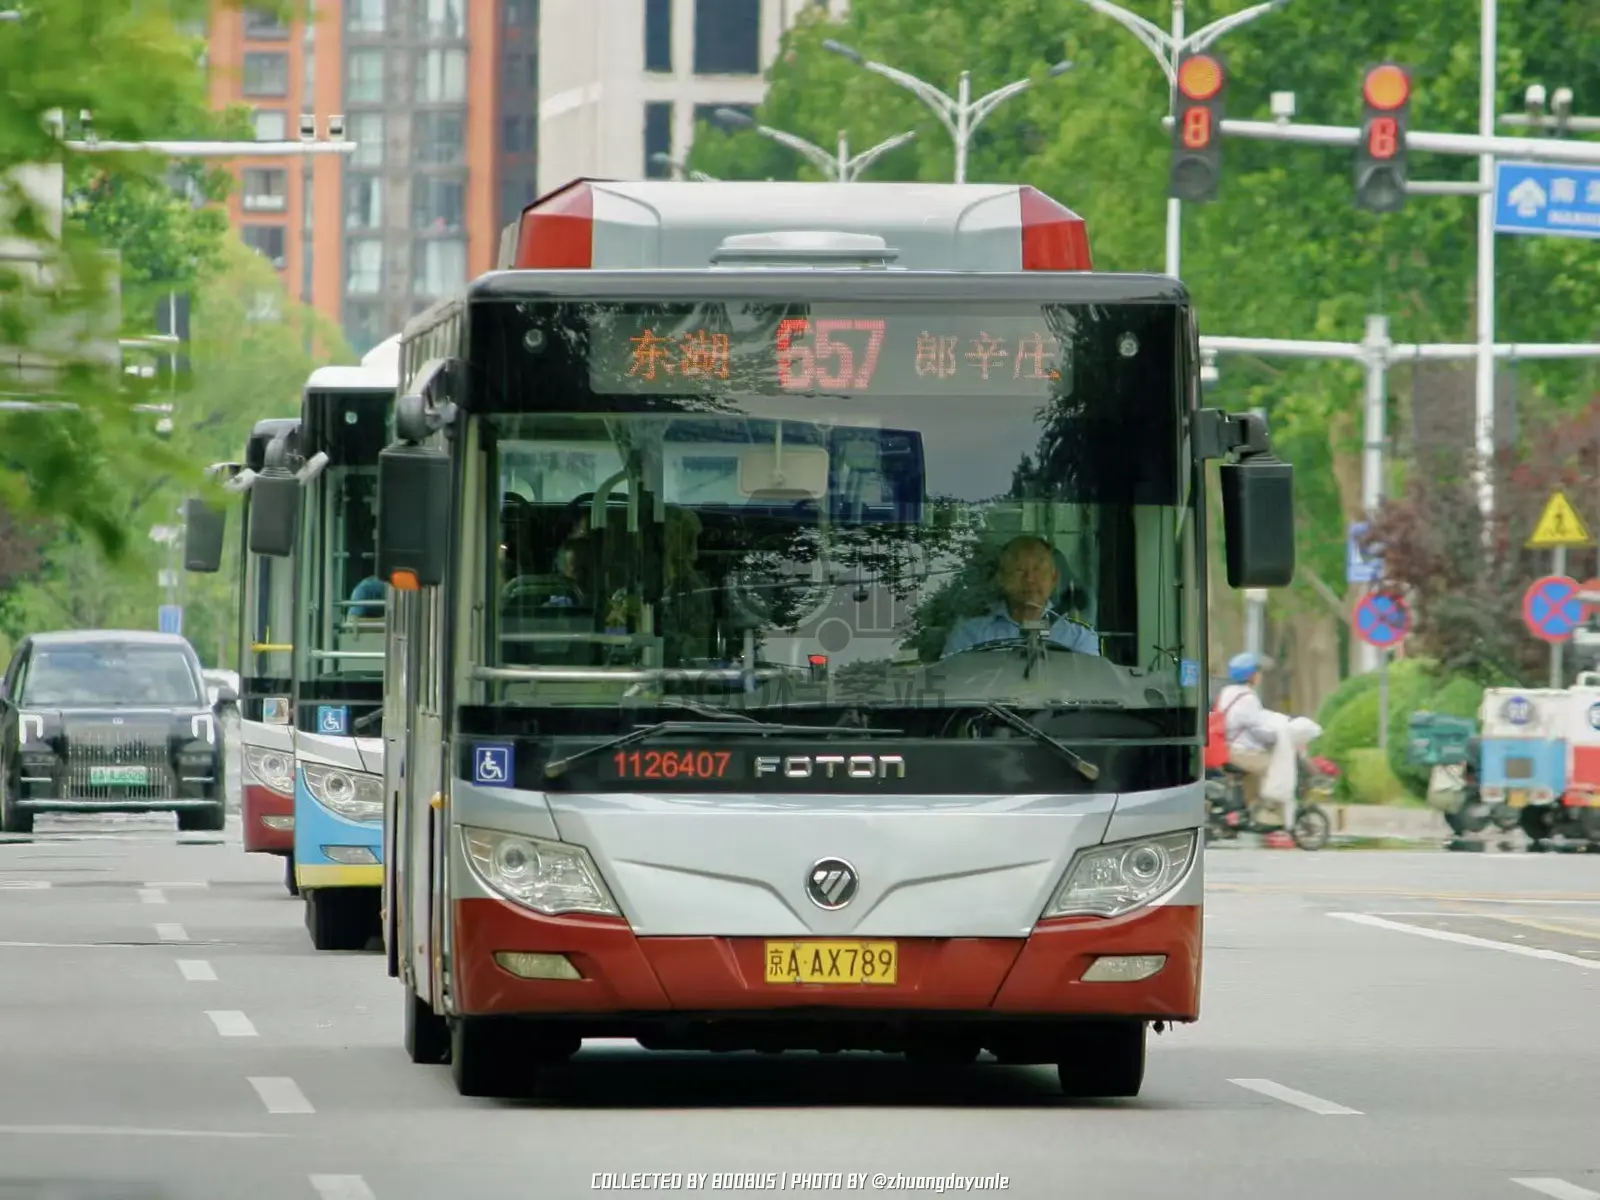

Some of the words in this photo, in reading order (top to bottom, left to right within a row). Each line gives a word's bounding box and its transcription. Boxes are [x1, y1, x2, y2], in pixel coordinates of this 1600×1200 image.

[628, 328, 730, 380] 东湖
[776, 318, 885, 389] 657
[914, 330, 1061, 381] 郎辛庄
[614, 752, 731, 778] 1126407
[755, 756, 905, 778] FOTON
